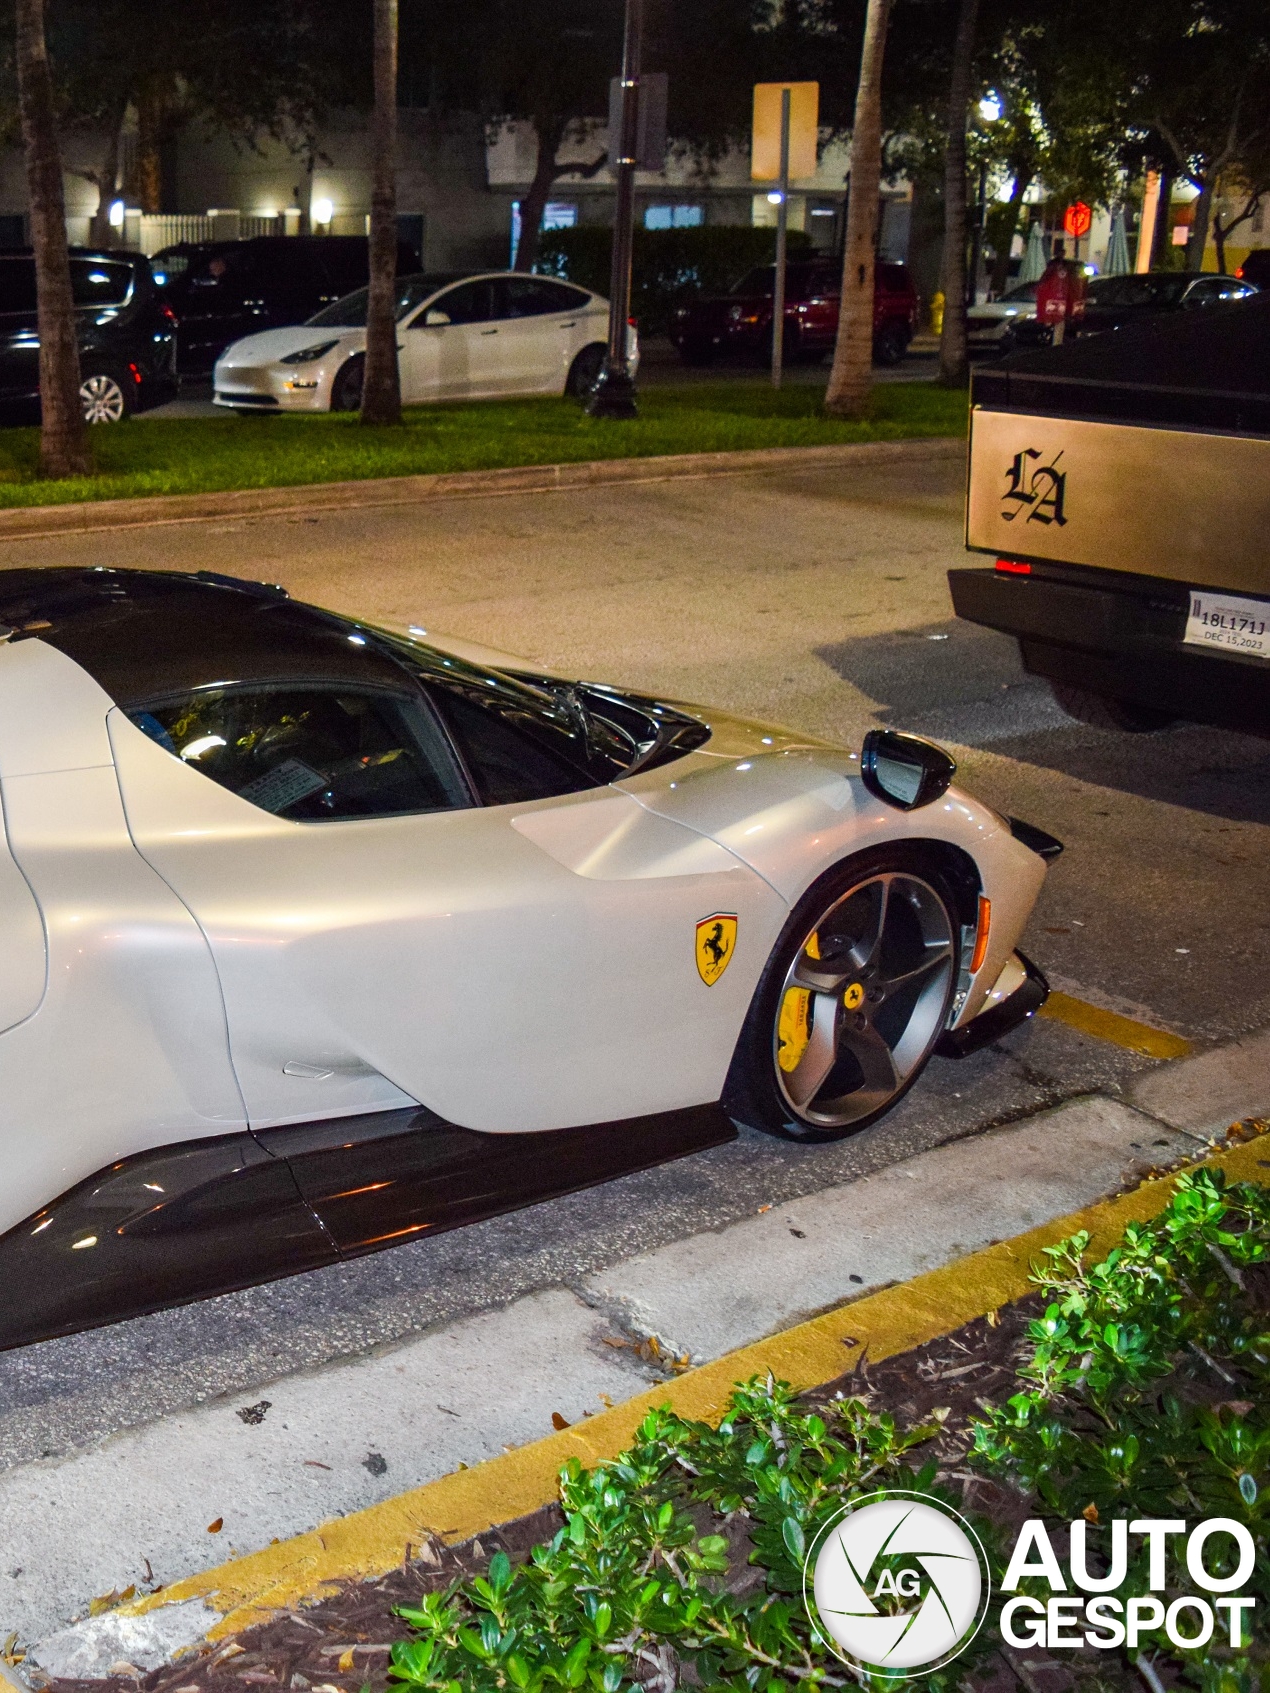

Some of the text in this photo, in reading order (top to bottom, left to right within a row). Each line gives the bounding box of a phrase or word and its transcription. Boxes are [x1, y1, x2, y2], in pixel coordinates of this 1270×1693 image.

[1202, 612, 1266, 635] 18L171J
[1204, 631, 1223, 642] DEC
[1226, 635, 1263, 649] 15,2023
